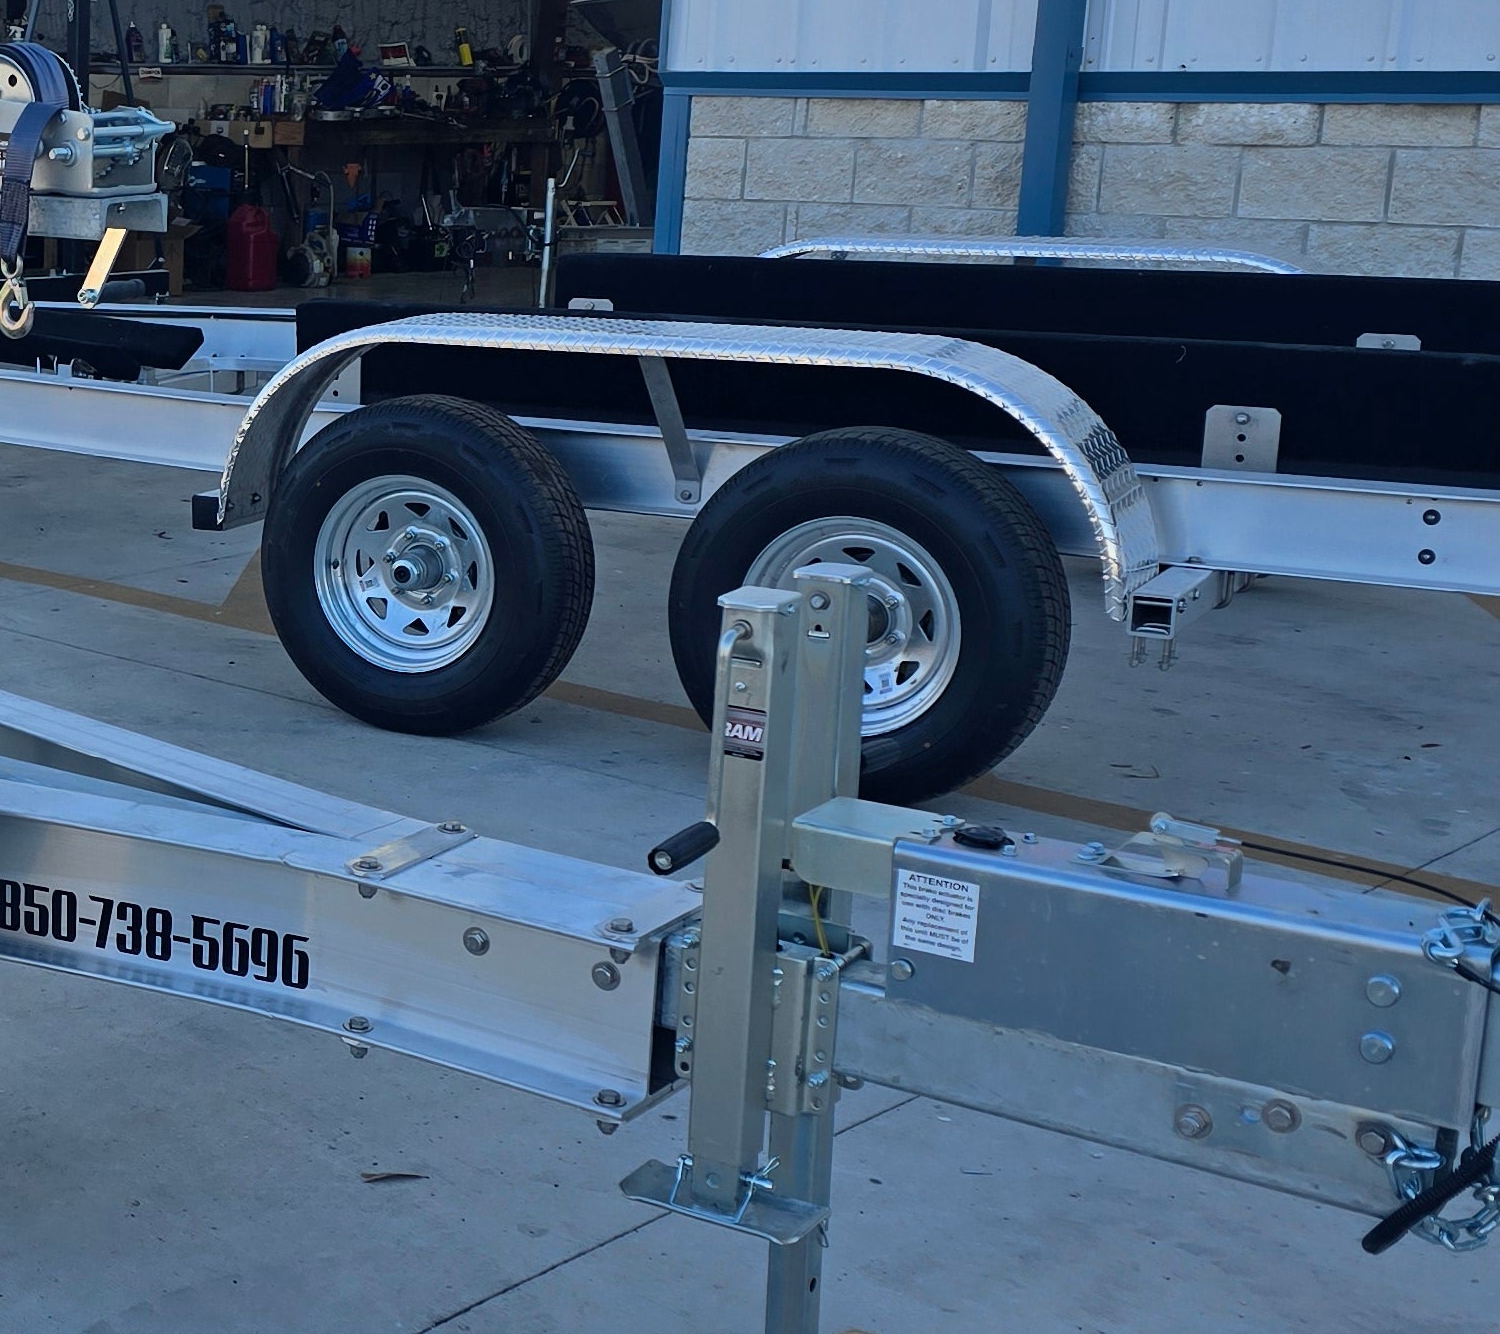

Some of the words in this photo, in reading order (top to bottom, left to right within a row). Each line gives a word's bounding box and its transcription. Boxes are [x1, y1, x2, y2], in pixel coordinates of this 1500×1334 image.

[902, 882, 917, 891] This
[918, 885, 937, 895] brake
[908, 873, 969, 893] ATTENTION
[900, 891, 930, 902] specially
[931, 897, 964, 909] designed
[915, 902, 931, 910] with
[931, 906, 946, 914] disc
[948, 909, 971, 919] brakes
[900, 925, 914, 933] this
[914, 928, 928, 936] unit
[929, 931, 950, 940] MUST
[951, 935, 961, 943] be
[902, 917, 915, 926] Any
[916, 921, 960, 934] replacement
[905, 934, 916, 942] the
